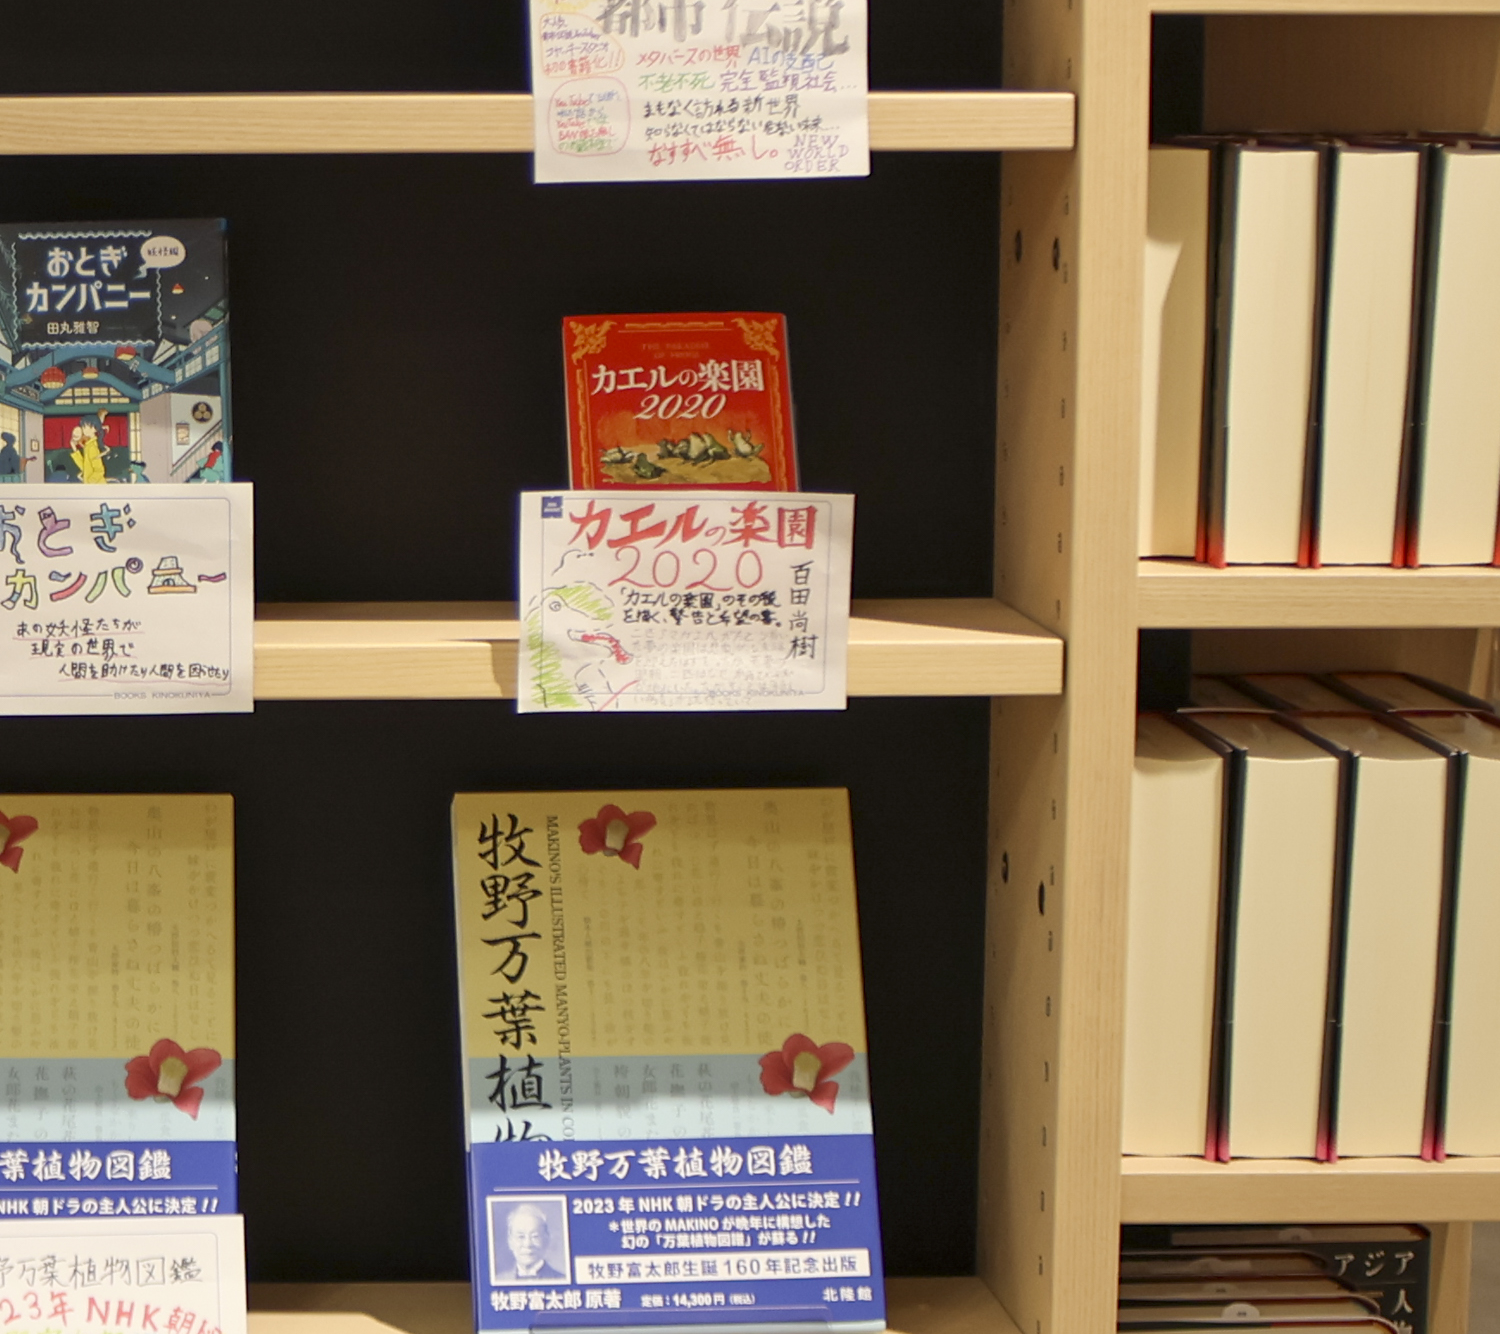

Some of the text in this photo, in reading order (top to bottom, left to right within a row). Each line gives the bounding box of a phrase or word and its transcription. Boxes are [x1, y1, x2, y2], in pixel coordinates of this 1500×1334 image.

[636, 44, 741, 69] メタバースの世界
[637, 70, 716, 93] 不老不死
[787, 144, 850, 160] WORLD
[793, 133, 841, 149] NEW
[784, 158, 842, 173] ORDER
[46, 244, 129, 278] おとぎ
[26, 281, 152, 313] カンパニー
[46, 321, 101, 335] 田丸雅智
[590, 358, 766, 396] カエルの楽園
[632, 393, 728, 421] 2020
[569, 498, 819, 550] カエルの楽園
[607, 545, 764, 592] 2020
[785, 559, 820, 661] 百田尚樹
[30, 636, 136, 662] 現実の世界で
[113, 691, 212, 700] BOOKS KINOKUNIYA
[549, 887, 568, 981] ILLUSTRATED
[537, 1144, 814, 1182] 牧野万葉植物図鑑
[587, 1255, 859, 1280] 牧野富太郎生誕160年記念出版
[1334, 1250, 1415, 1278] アジア
[490, 1289, 622, 1312] 牧野富太郎 原著
[822, 1286, 873, 1302] 北隆館
